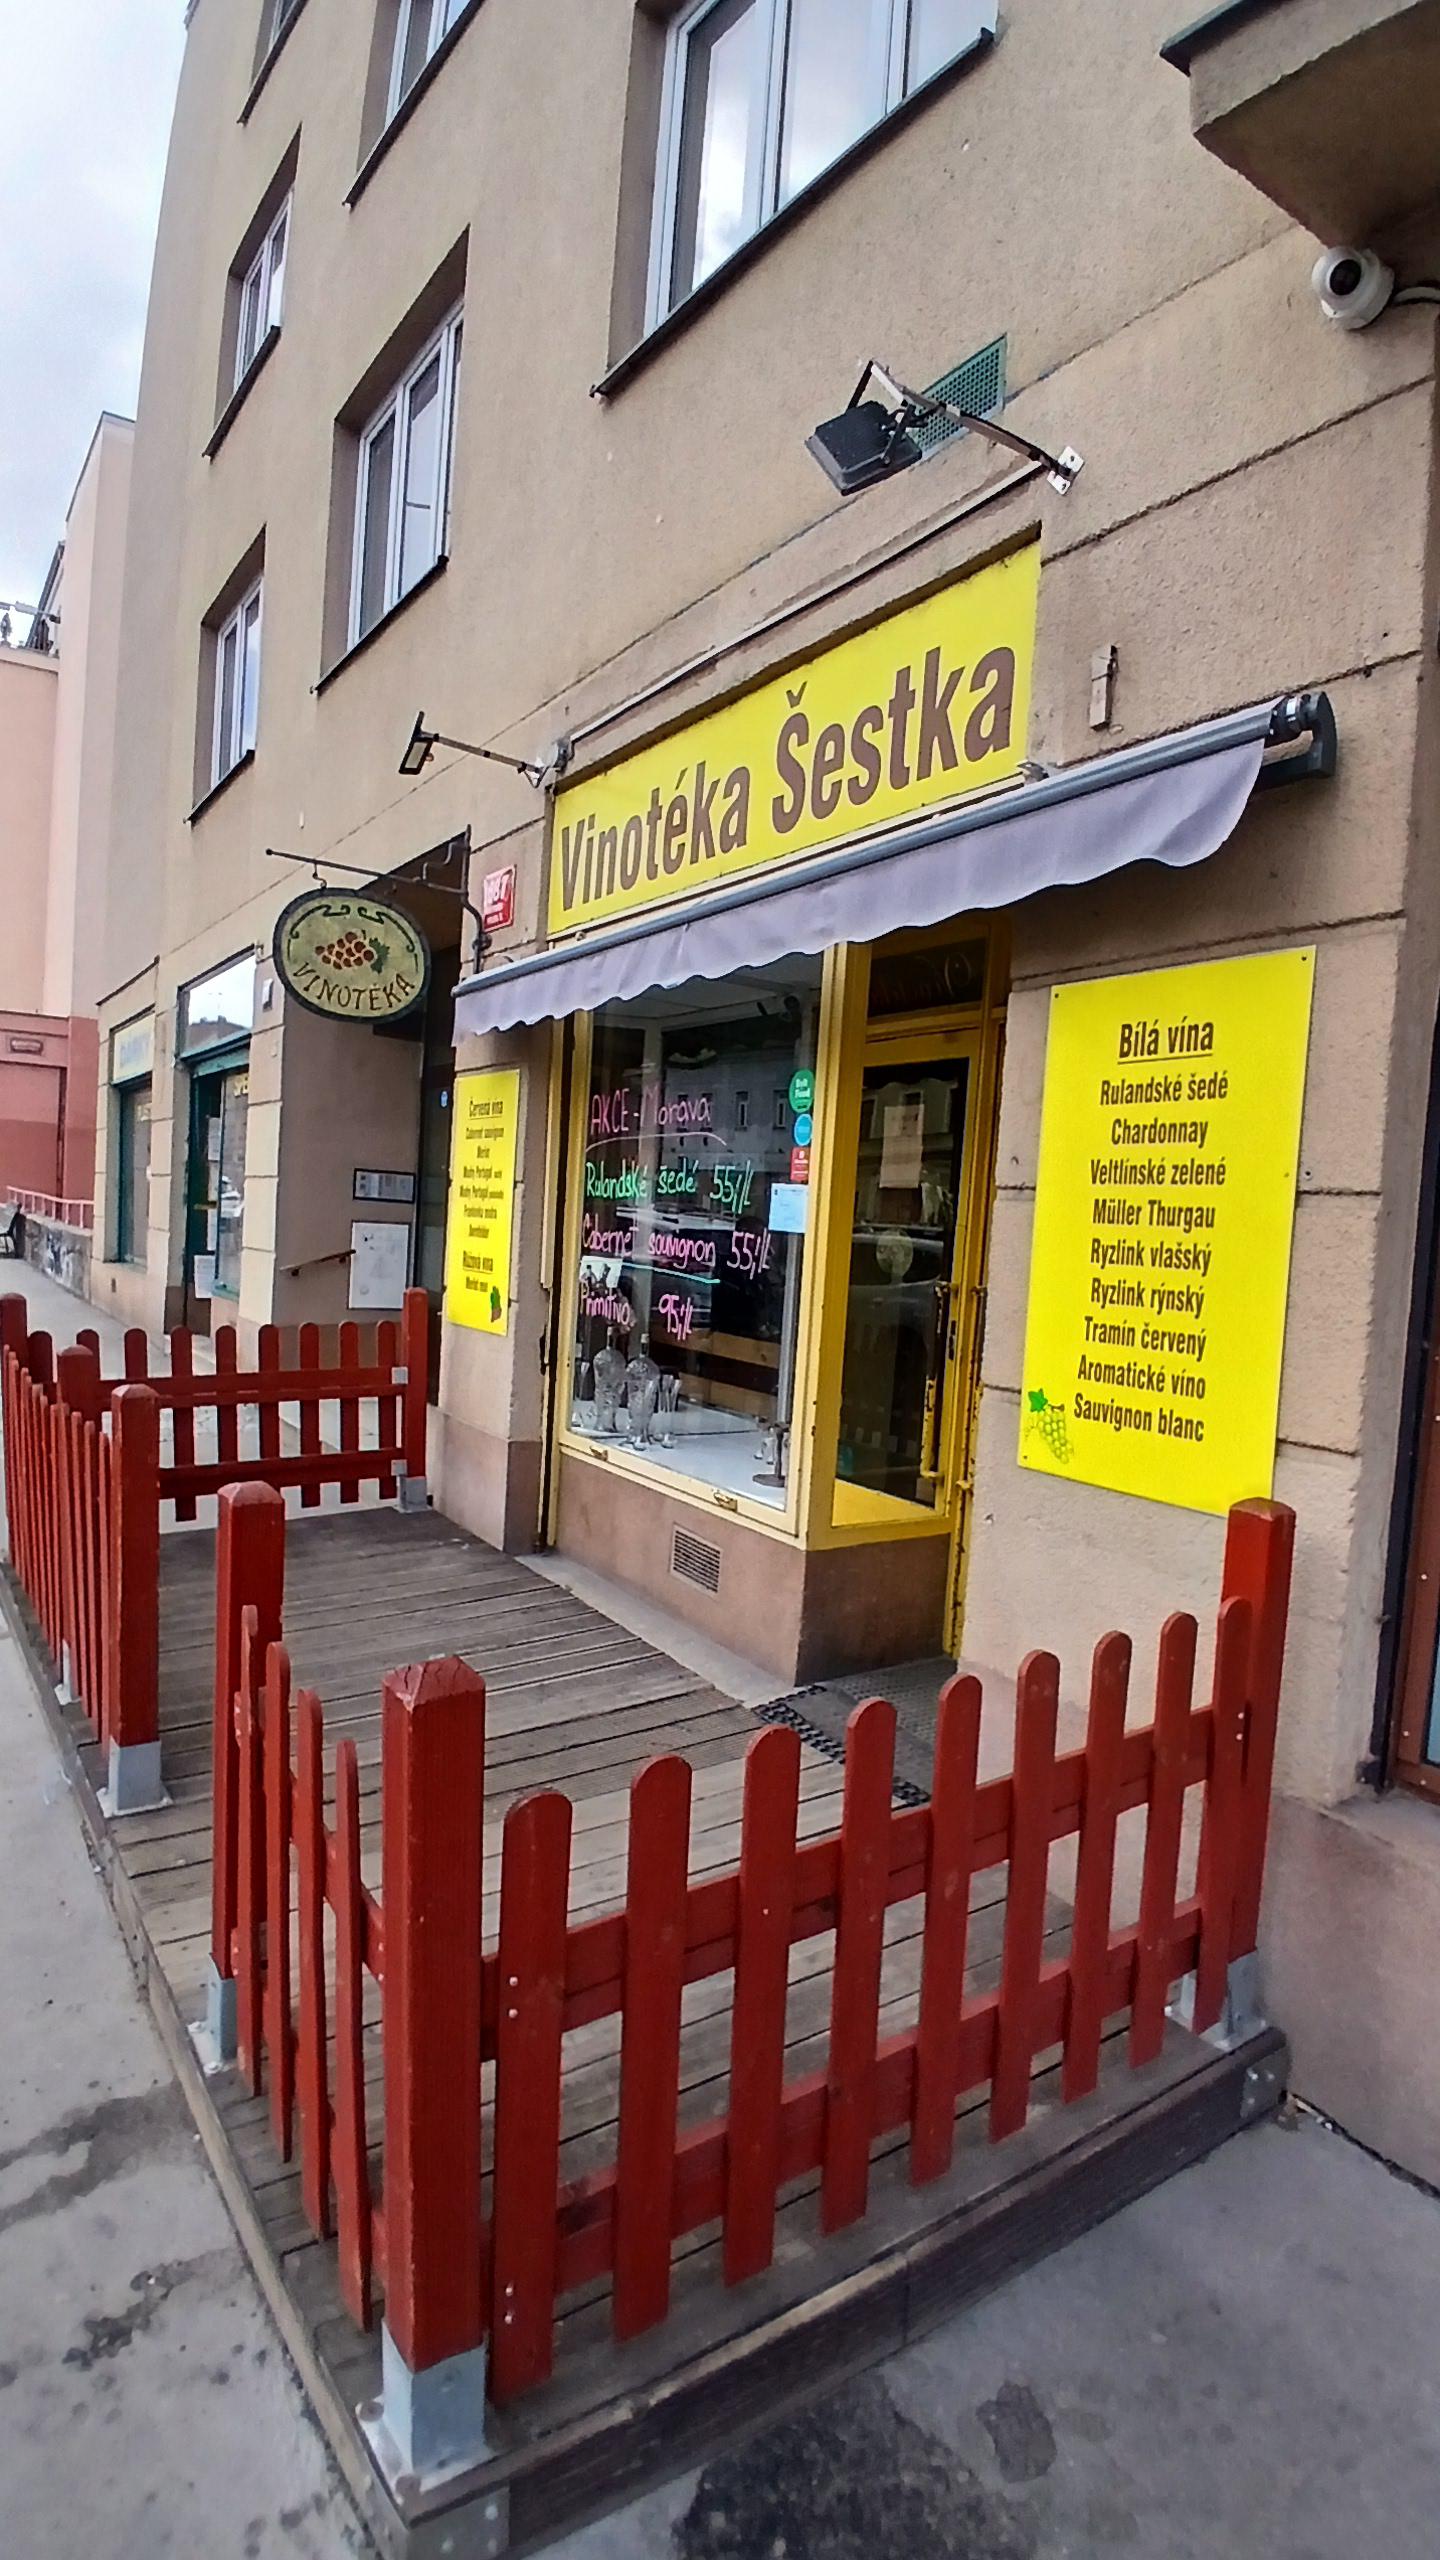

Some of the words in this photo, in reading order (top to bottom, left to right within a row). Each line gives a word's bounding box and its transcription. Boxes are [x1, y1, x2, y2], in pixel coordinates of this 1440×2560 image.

[561, 760, 751, 911] Vinotéka
[771, 646, 1015, 834] Šestka
[293, 962, 416, 1011] VINOTÉKA
[1118, 1019, 1160, 1059] Bílá
[1168, 1016, 1214, 1053] vína
[1100, 1073, 1182, 1106] Rulandské
[1187, 1070, 1229, 1100] šedé
[590, 1088, 630, 1135] AKCE
[1111, 1117, 1208, 1149] Chardonnay
[1090, 1157, 1166, 1186] Veltlínské
[1171, 1156, 1226, 1186] zelené
[1092, 1198, 1142, 1226] Müller
[1148, 1199, 1216, 1234] Thurgau
[1090, 1238, 1144, 1269] Ryzlink
[1150, 1241, 1212, 1277] vlašský
[1090, 1278, 1145, 1308] Ryzlink
[1150, 1282, 1205, 1319] rýnský
[1084, 1316, 1135, 1347] Tramín
[1141, 1322, 1207, 1362] červený
[1077, 1354, 1165, 1393] Aromatické
[1171, 1368, 1206, 1399] víno
[1073, 1392, 1152, 1432] Sauvignon
[1157, 1408, 1205, 1442] blanc
